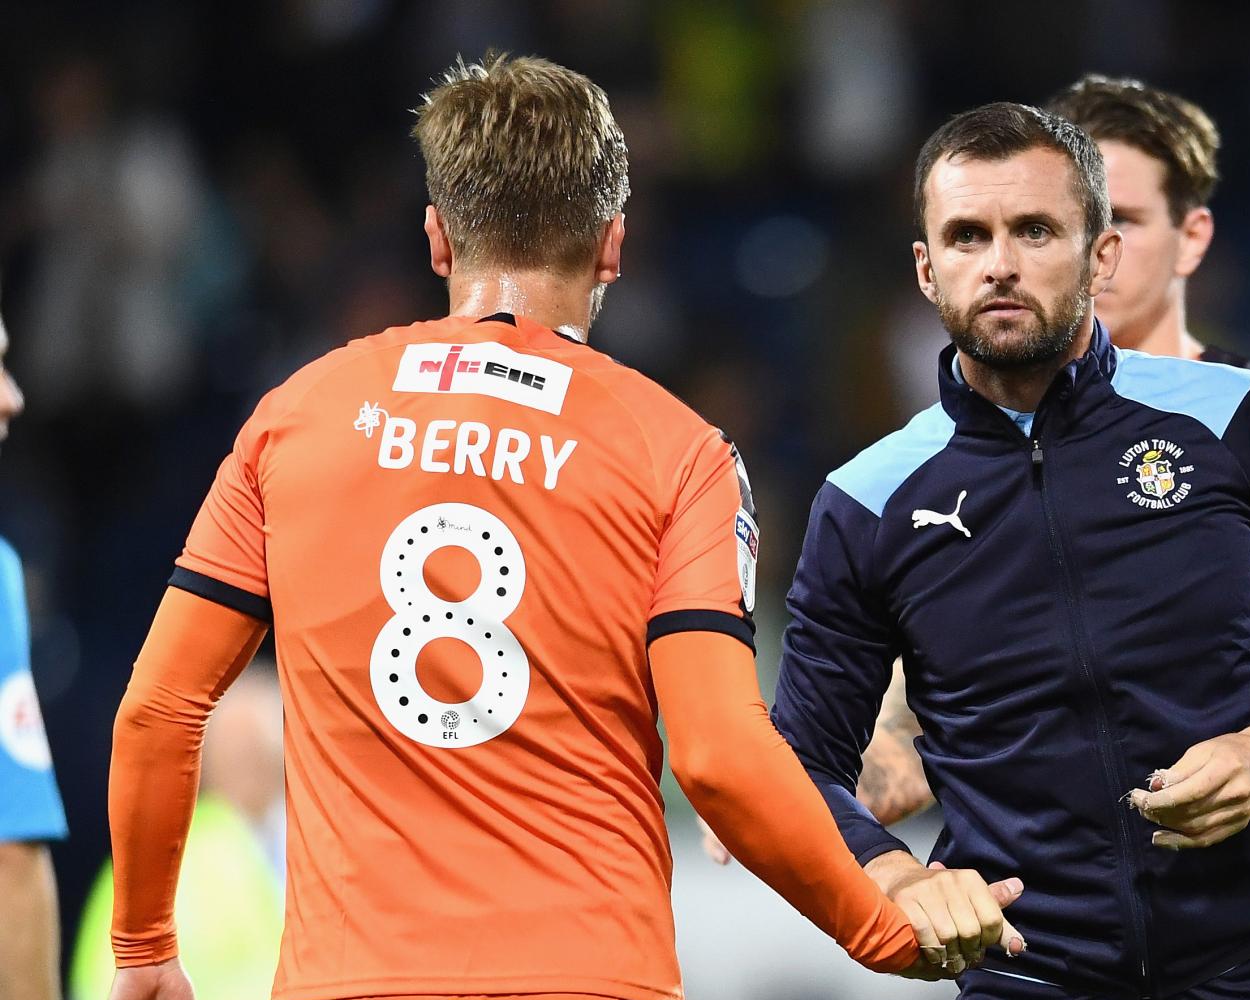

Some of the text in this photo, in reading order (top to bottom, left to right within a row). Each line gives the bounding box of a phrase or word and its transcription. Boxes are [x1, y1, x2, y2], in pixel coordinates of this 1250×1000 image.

[377, 417, 578, 490] BERRY
[1119, 439, 1184, 467] LUTON TOWN
[1127, 482, 1191, 509] FOOTBALL CLUB
[369, 502, 530, 749] 8
[442, 731, 459, 740] EFL
